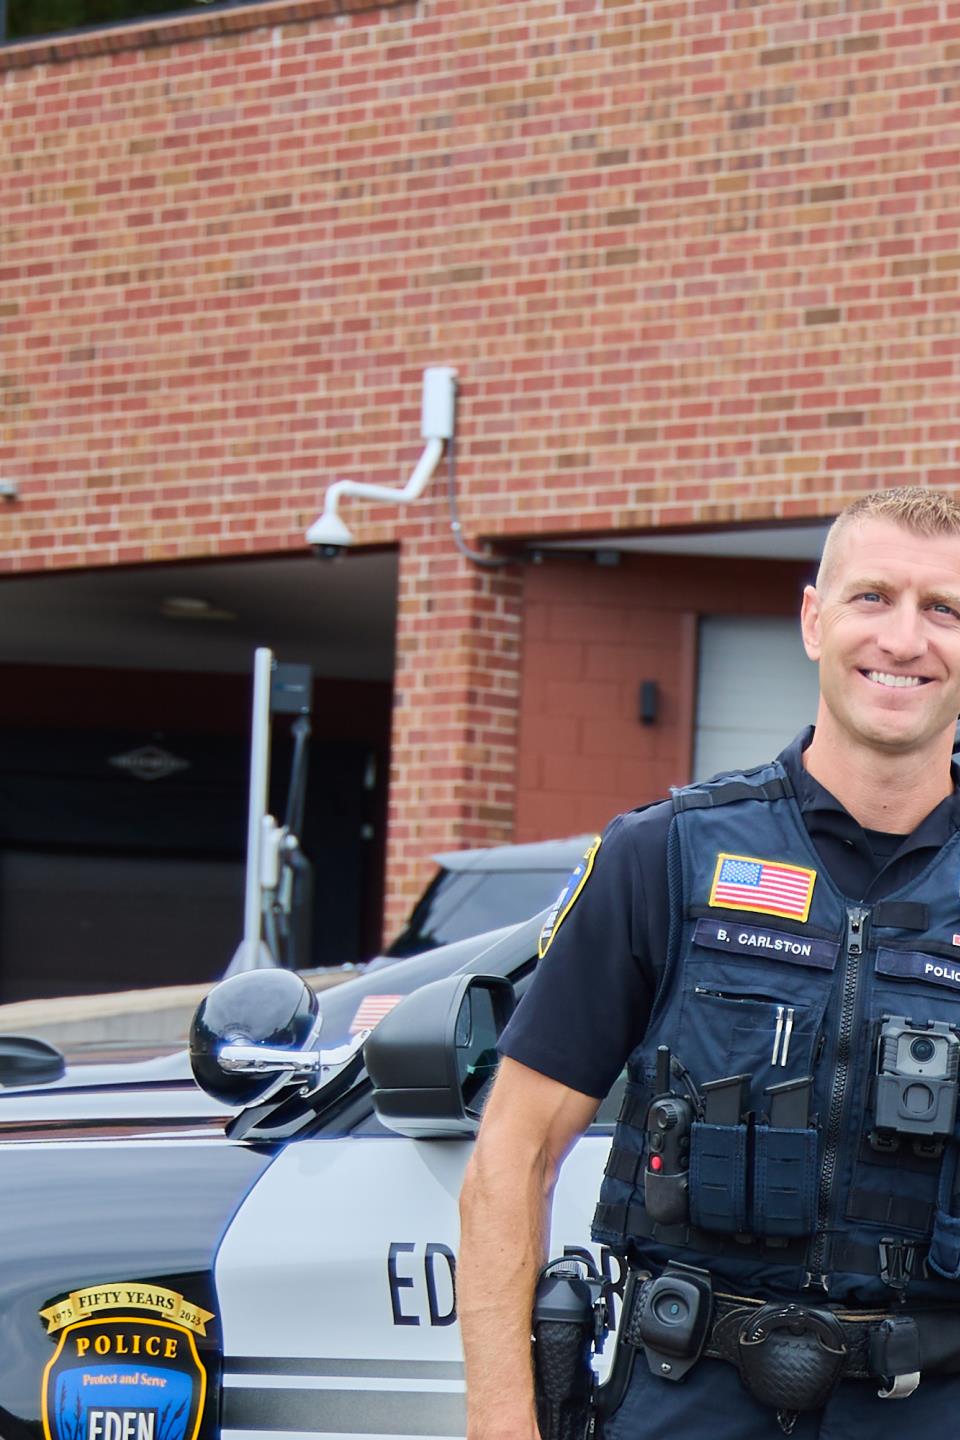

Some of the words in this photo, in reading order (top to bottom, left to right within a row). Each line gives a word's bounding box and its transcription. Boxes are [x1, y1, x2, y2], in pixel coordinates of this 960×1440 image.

[717, 930, 731, 943] B.
[738, 932, 812, 957] CARLSTON
[388, 1242, 458, 1327] ED
[78, 1291, 121, 1310] FIFTY
[125, 1291, 175, 1310] YEARS
[180, 1309, 202, 1327] 2023
[76, 1334, 178, 1359] POLICE
[82, 1373, 117, 1387] Protect
[120, 1372, 139, 1385] and
[141, 1373, 167, 1388] Serve
